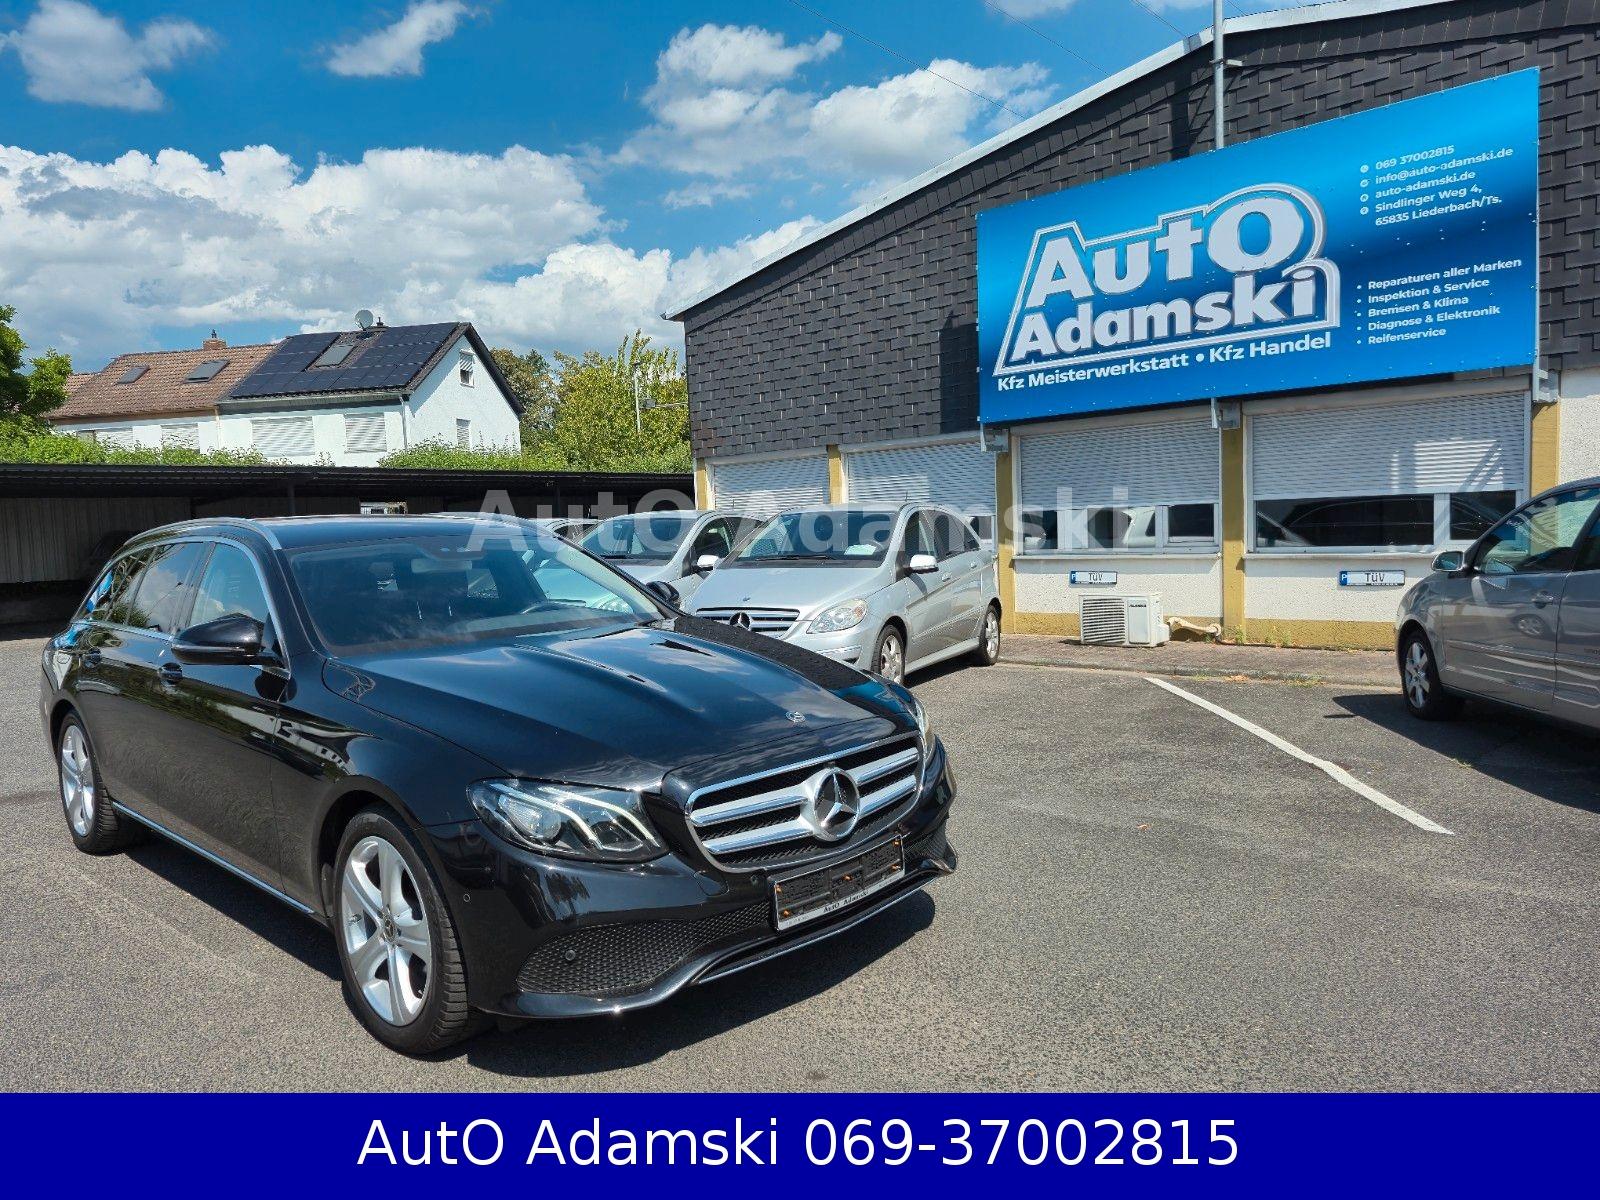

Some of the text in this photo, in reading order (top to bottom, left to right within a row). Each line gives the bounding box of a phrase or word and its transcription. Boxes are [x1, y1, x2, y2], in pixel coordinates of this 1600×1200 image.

[1375, 147, 1514, 185] info@auto-adamski.de
[1375, 170, 1476, 199] auto-adamski.de
[1375, 184, 1483, 213] Sindlinger Weg 4,
[1375, 195, 1503, 226] 65835 Liederbach/Ts.
[1368, 258, 1522, 290] Reparaturen aller Marken
[1368, 277, 1490, 304] Inspektion & Service
[1010, 269, 1316, 362] Adamski
[1368, 295, 1469, 317] Bremsen & Klima
[1368, 305, 1501, 331] Diagnose & Elektronik
[1368, 328, 1447, 345] Reifenservice
[998, 331, 1331, 391] Kfz Meisterwerkstatt Kfz Handel
